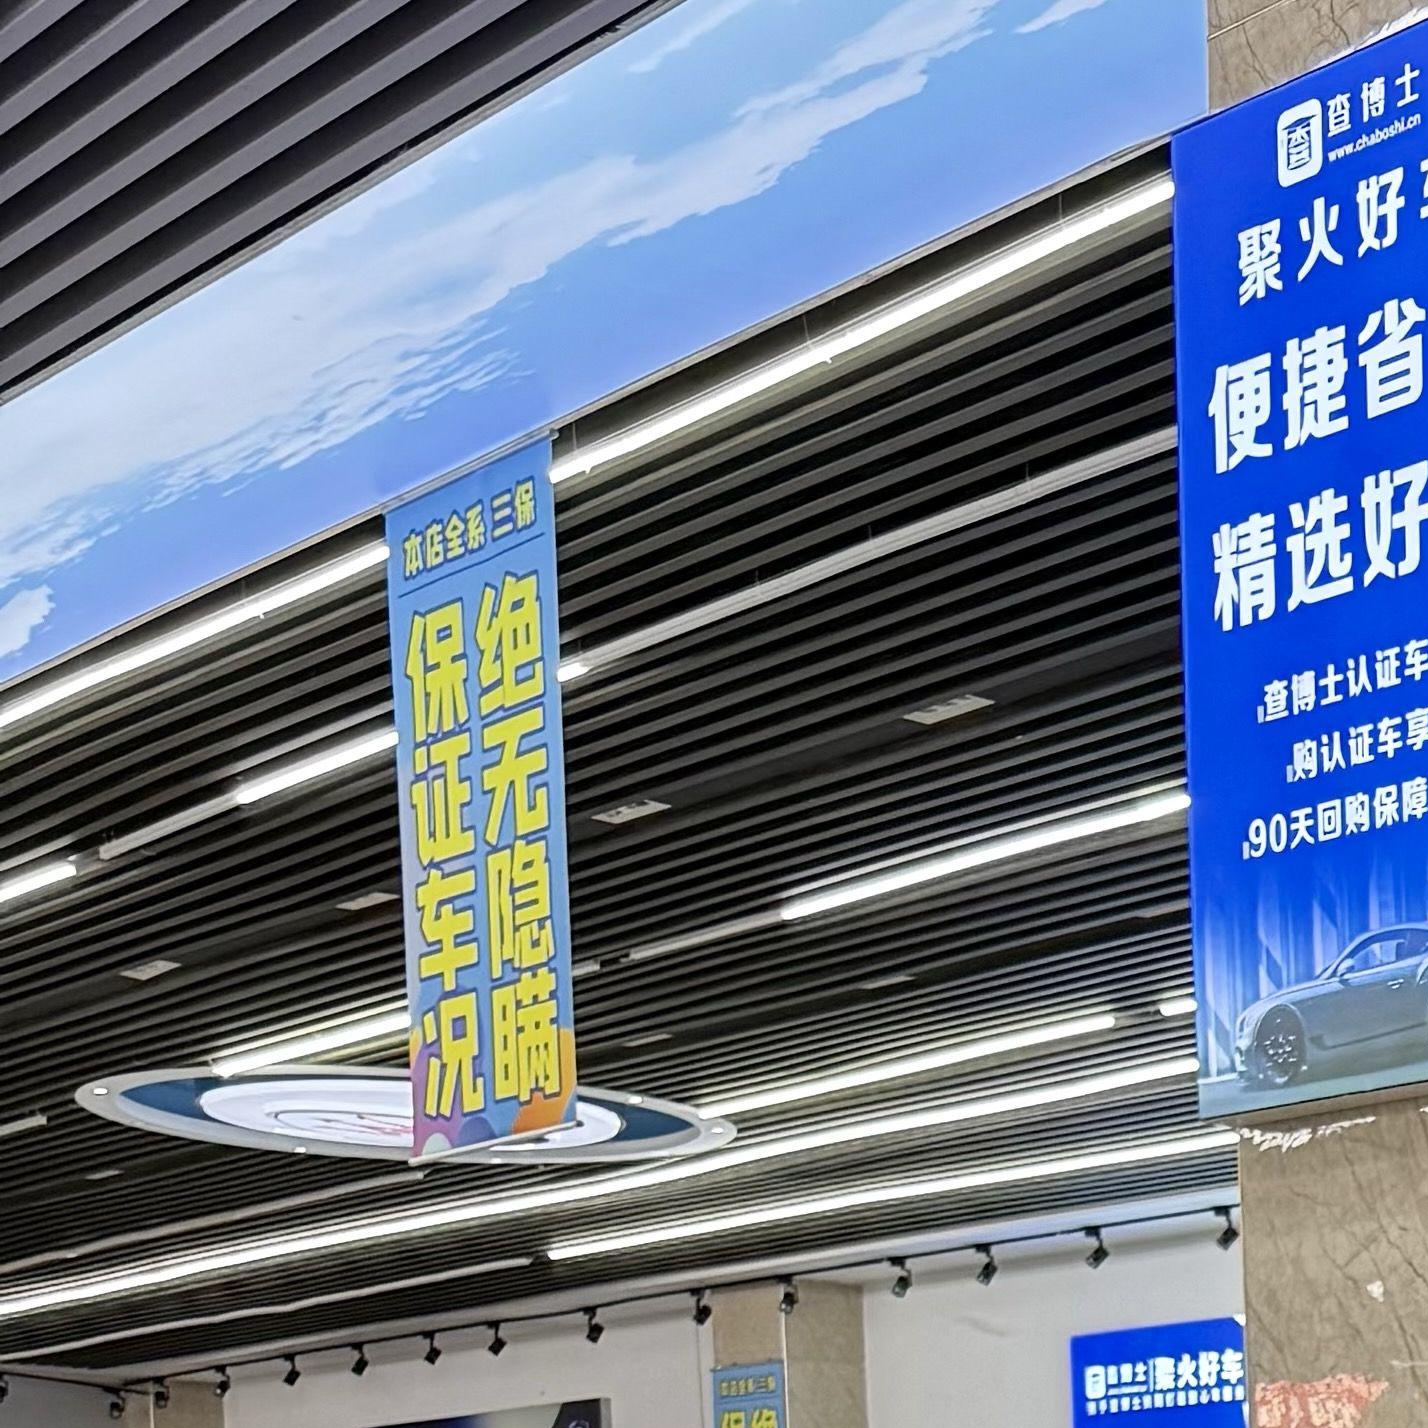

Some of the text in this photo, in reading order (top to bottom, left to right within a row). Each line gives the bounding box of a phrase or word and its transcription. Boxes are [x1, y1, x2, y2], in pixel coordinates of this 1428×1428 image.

[1327, 63, 1421, 138] 查博士
[1328, 113, 1421, 163] www.chaboshi.cn
[404, 478, 537, 576] 本店全系 三保
[404, 598, 485, 1119] 保证车况
[475, 571, 561, 1103] 绝无隐瞒
